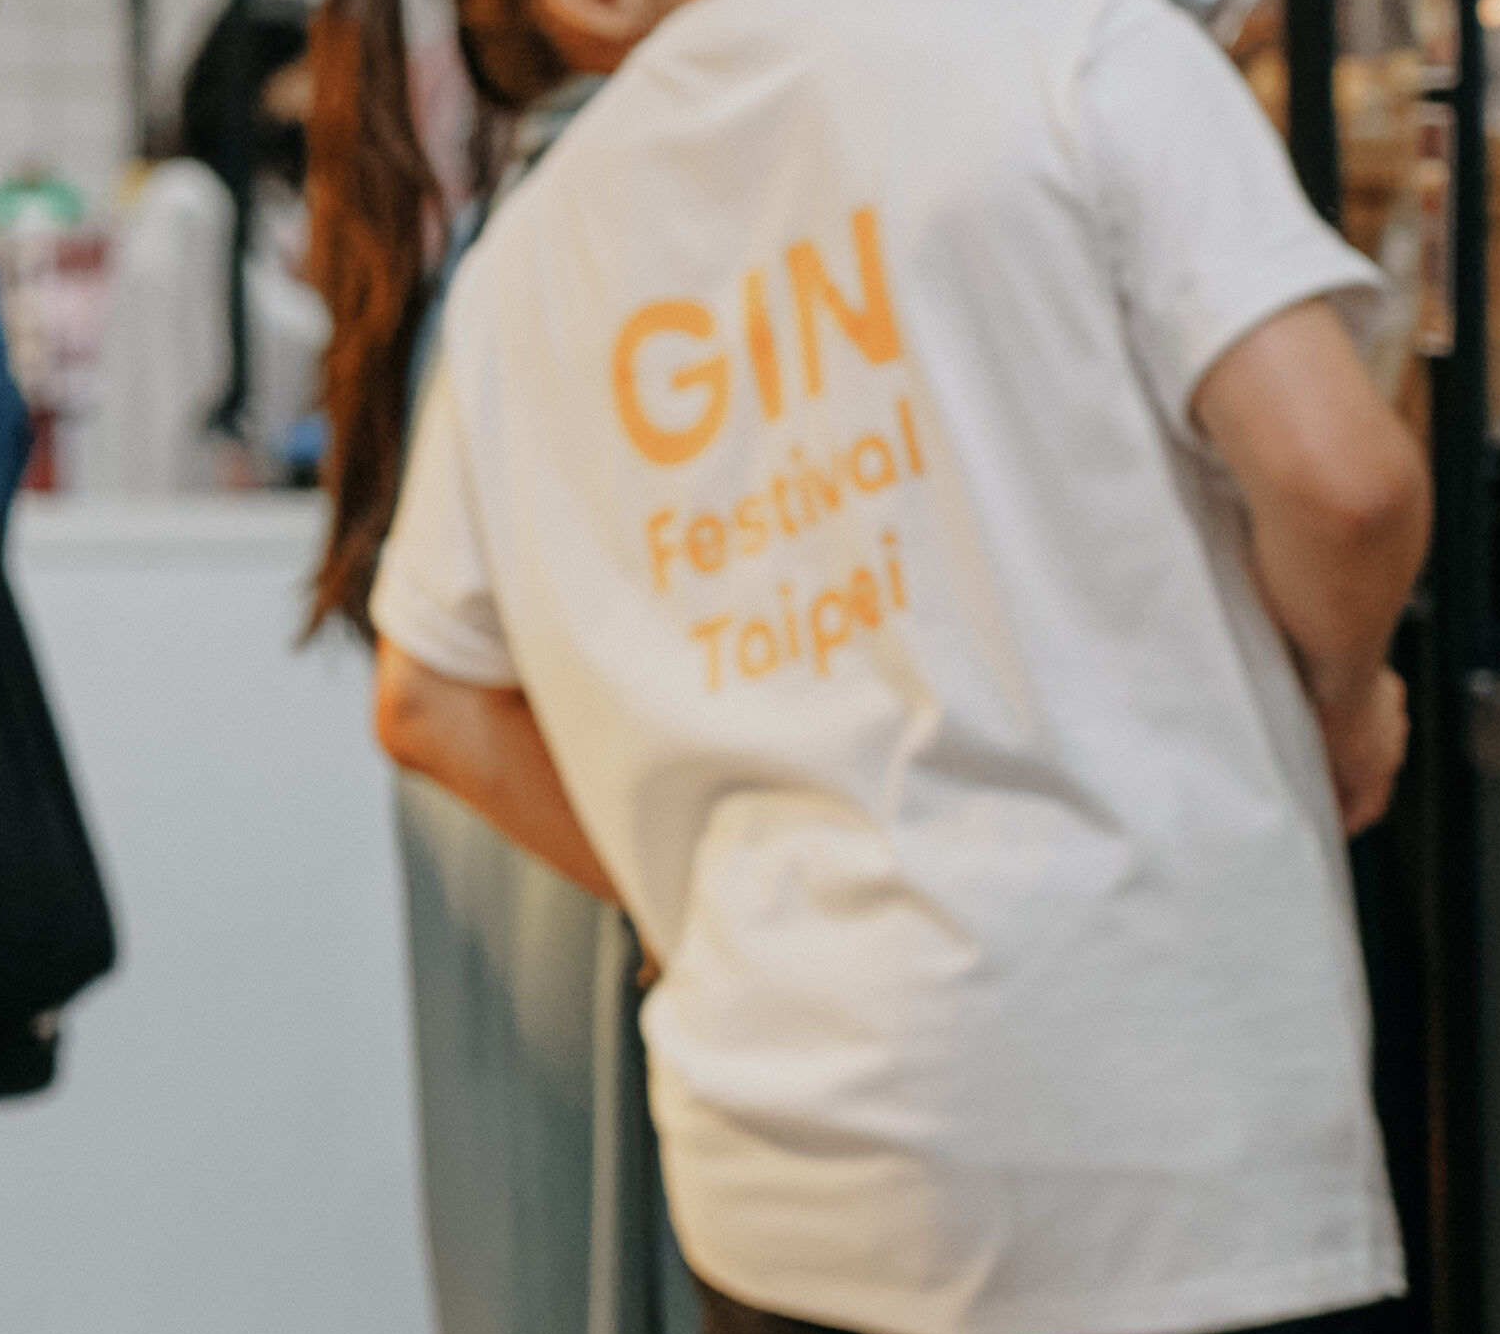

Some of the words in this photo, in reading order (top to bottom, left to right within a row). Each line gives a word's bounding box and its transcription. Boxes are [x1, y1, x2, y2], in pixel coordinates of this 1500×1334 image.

[610, 205, 902, 465] GIN
[645, 397, 924, 594] Festival
[691, 531, 906, 691] Taipei
